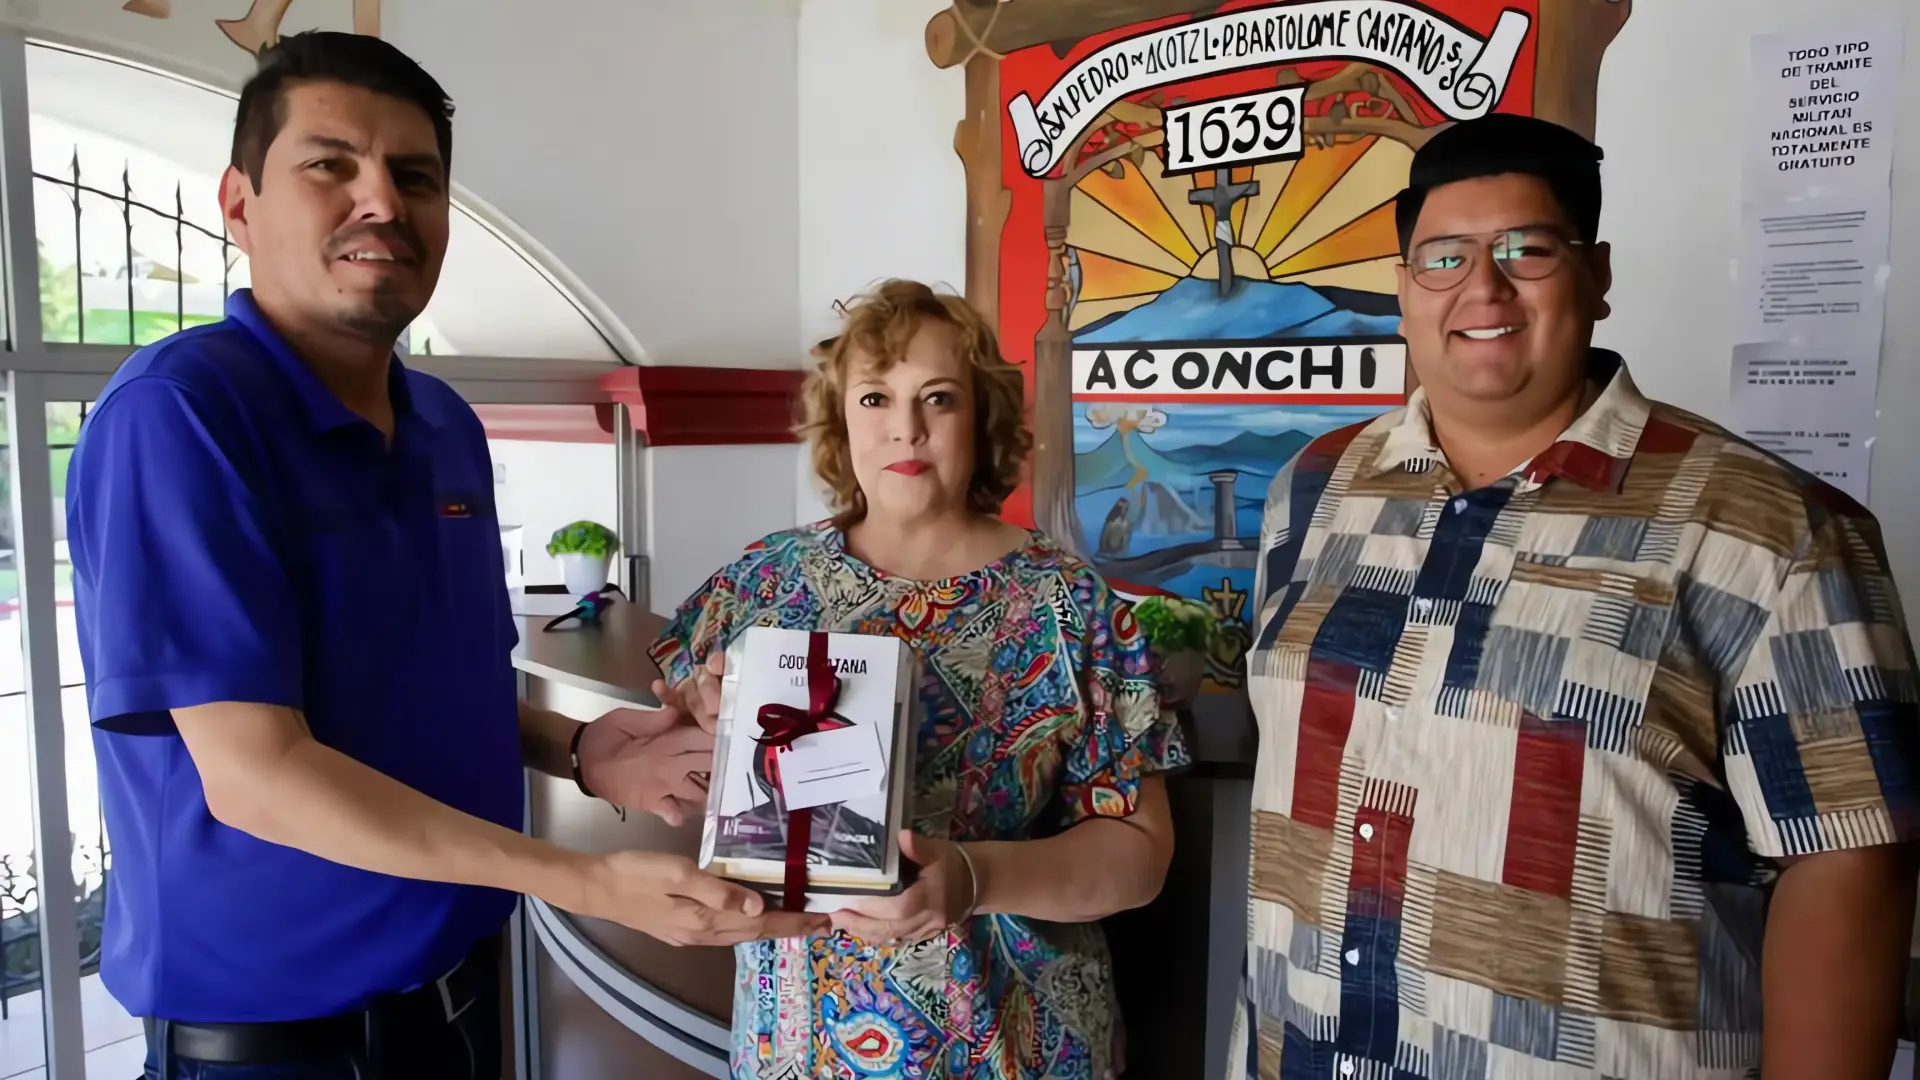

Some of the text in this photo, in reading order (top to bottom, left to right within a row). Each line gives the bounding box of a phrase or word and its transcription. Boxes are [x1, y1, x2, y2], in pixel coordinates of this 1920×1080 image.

[1788, 41, 1870, 62] TODO TIPO
[1810, 77, 1840, 91] DEL
[1788, 91, 1859, 109] SERVICIO
[1174, 96, 1295, 164] 1639
[1771, 121, 1873, 141] NACIONAL ES
[1772, 138, 1871, 156] TOTALMENTE
[1778, 155, 1856, 171] GRATUITO
[1085, 345, 1377, 391] ACONCHI
